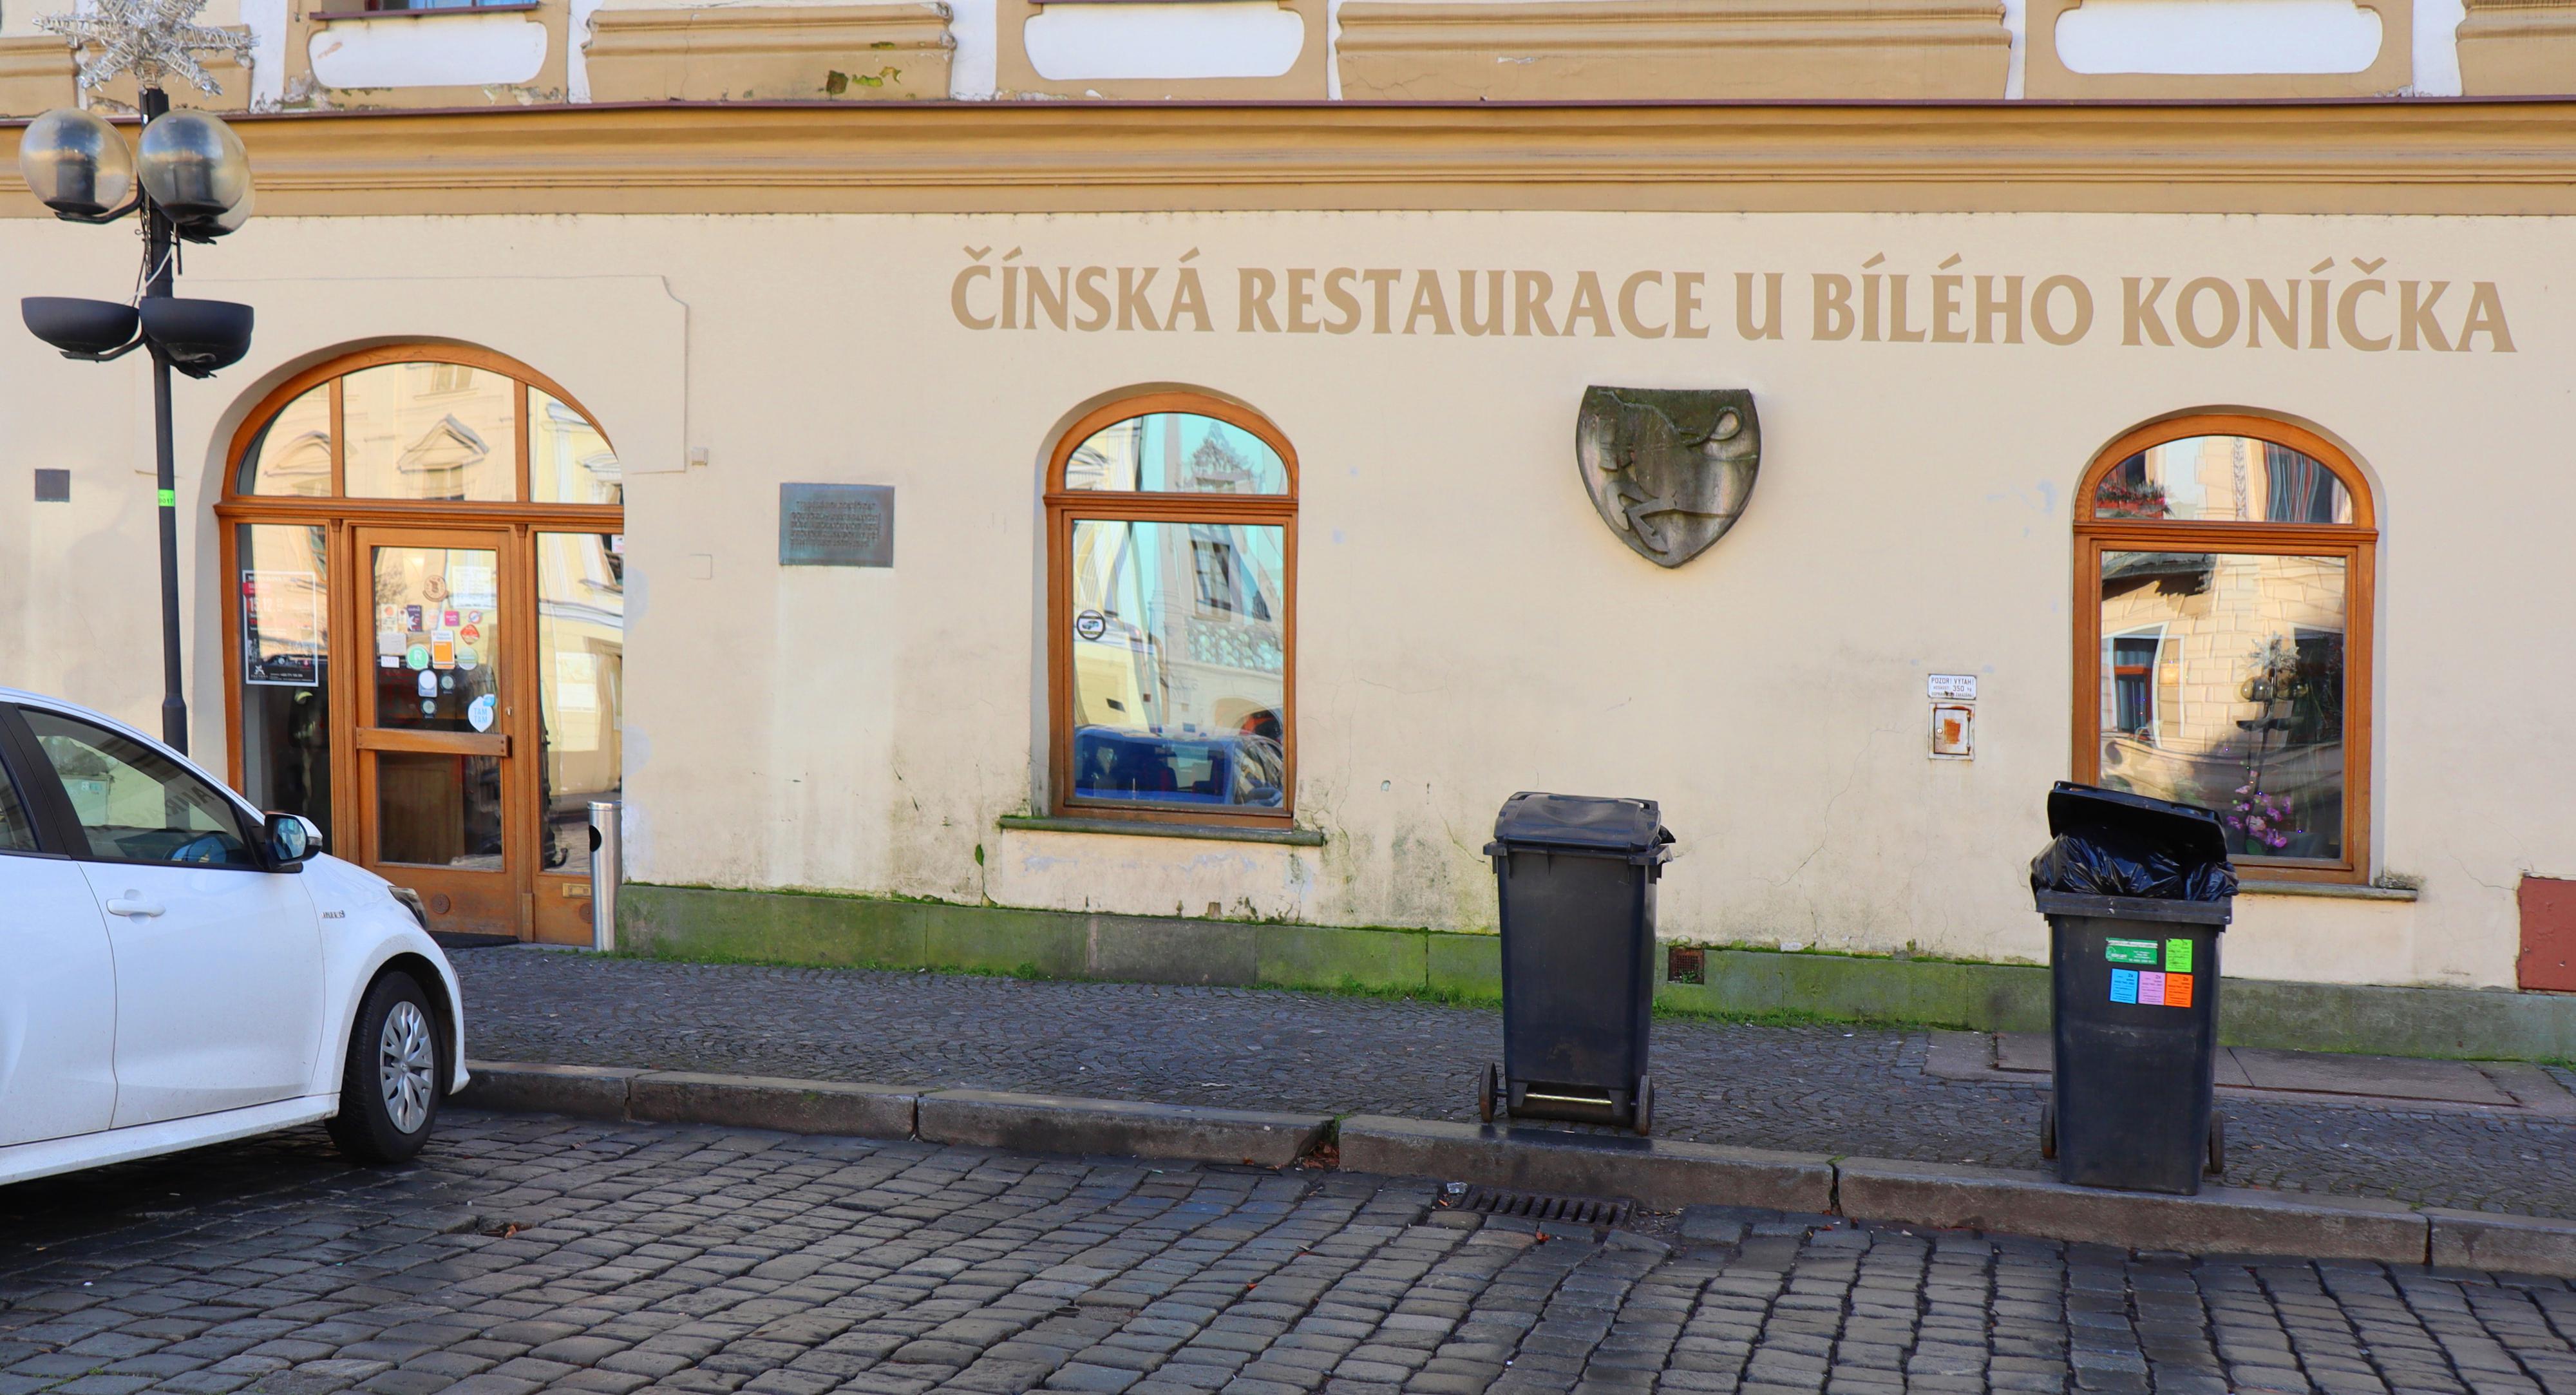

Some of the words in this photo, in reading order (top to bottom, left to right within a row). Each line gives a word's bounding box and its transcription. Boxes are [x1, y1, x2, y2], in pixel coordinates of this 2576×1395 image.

[951, 247, 1214, 332] ČÍNSKÁ
[1236, 267, 1710, 338] RESTAURACE
[1734, 272, 1783, 339] U
[1812, 253, 2092, 345] BÍLÉHO
[2121, 257, 2517, 352] KONÍČKA
